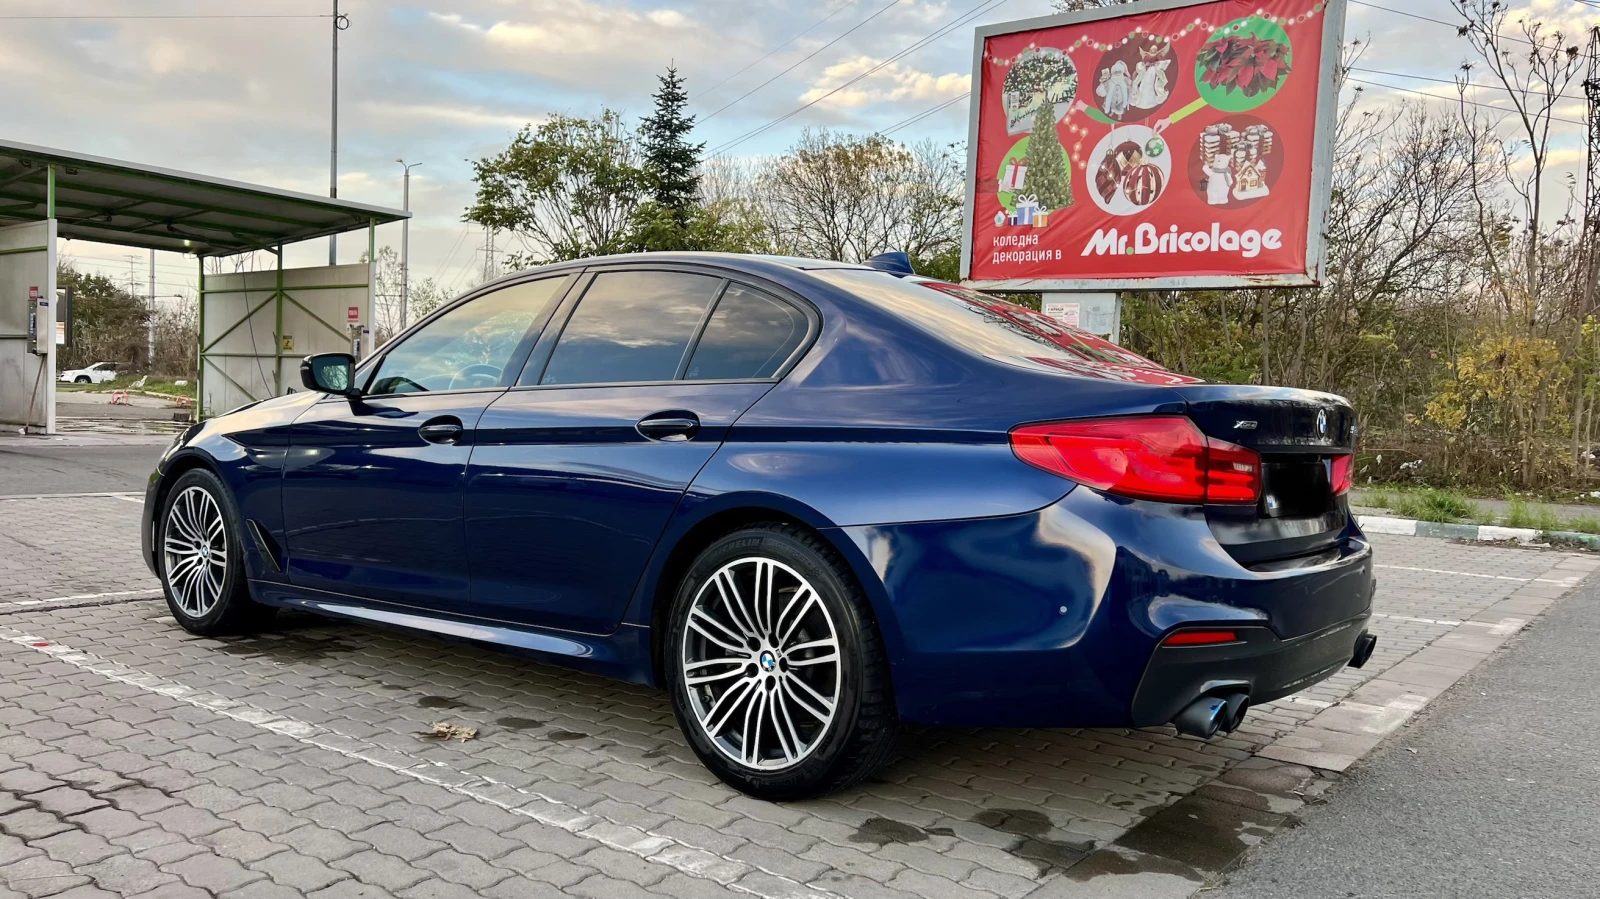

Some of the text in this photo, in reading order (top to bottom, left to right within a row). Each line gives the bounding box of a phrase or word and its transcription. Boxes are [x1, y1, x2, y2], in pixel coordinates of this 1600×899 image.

[993, 234, 1039, 248] коледна
[1080, 222, 1282, 258] Mr.Bricolage
[992, 249, 1062, 265] декорация в
